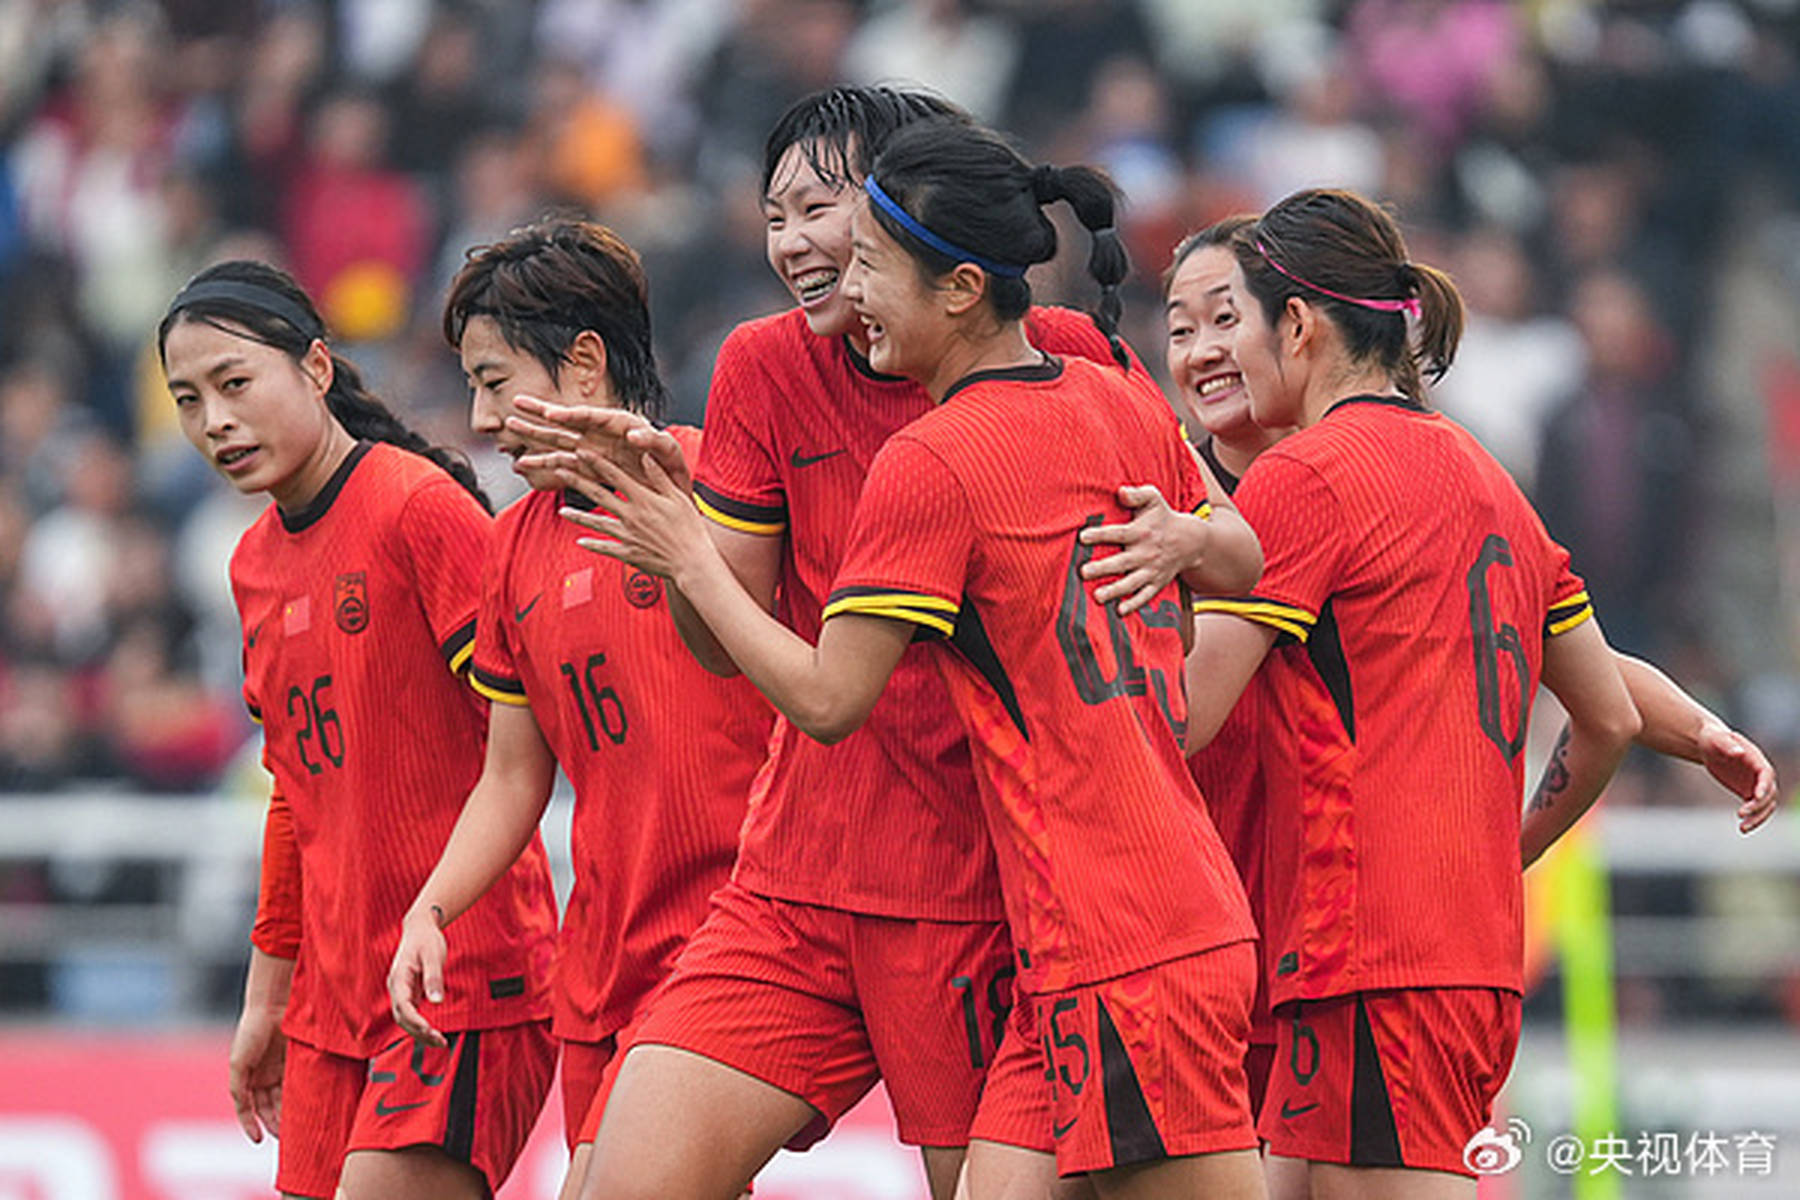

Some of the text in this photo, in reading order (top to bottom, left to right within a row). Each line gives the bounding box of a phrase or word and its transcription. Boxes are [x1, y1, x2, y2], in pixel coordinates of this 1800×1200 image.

[1467, 534, 1531, 766] 6
[287, 675, 345, 775] 26
[561, 653, 628, 752] 16
